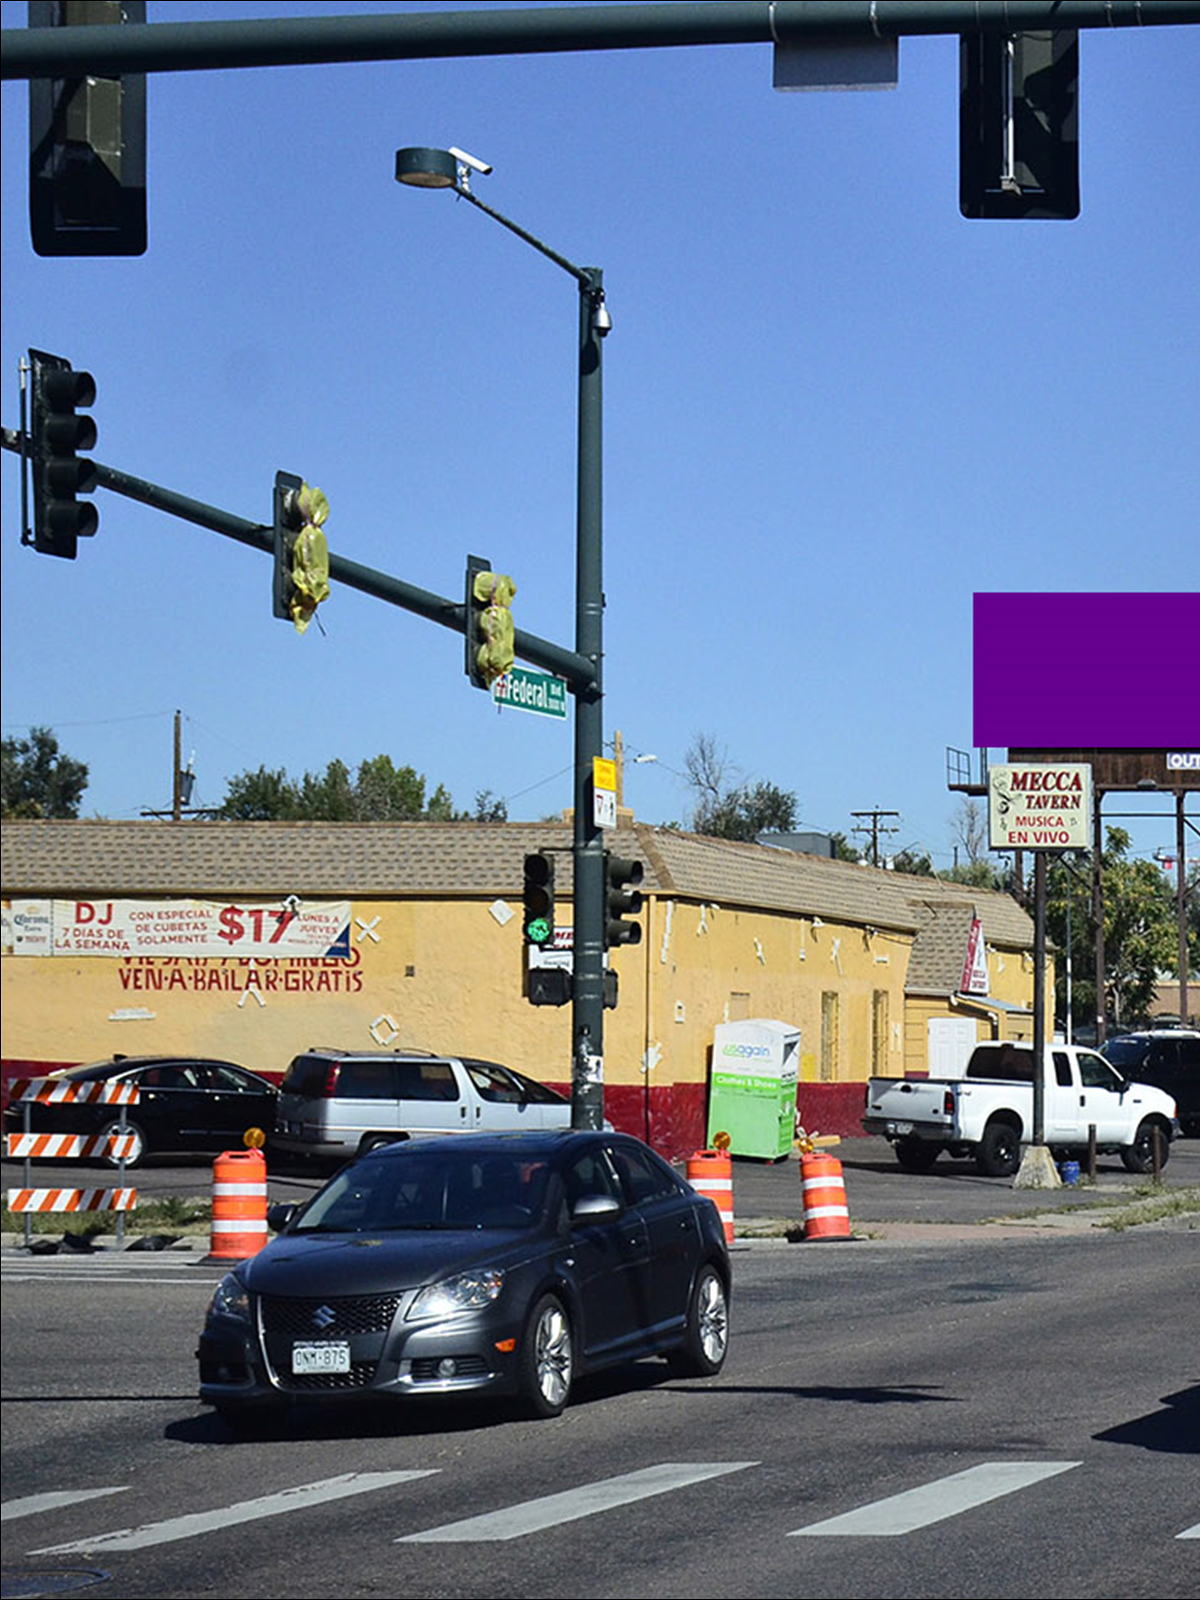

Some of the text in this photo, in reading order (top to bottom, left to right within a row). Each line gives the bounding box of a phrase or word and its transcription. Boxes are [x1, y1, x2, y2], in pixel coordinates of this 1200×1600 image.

[507, 674, 548, 708] Federal
[1010, 771, 1083, 791] MECCA
[1025, 794, 1081, 809] TAVERN
[1015, 816, 1064, 827] MUSICA
[1008, 831, 1070, 844] EN VIVO
[75, 902, 113, 925] DJ
[129, 909, 212, 920] CON ESPECIAL
[297, 914, 340, 924] LUNES A
[14, 914, 49, 926] Corona
[217, 905, 298, 946] $17
[62, 927, 124, 940] 7 DIAS DE
[135, 922, 208, 933] DE CUBETAS
[299, 925, 338, 935] JUEVES
[55, 939, 130, 951] LA SEMANA
[137, 934, 208, 945] SOLAMENTE
[119, 968, 162, 990] VEN
[168, 968, 187, 990] A
